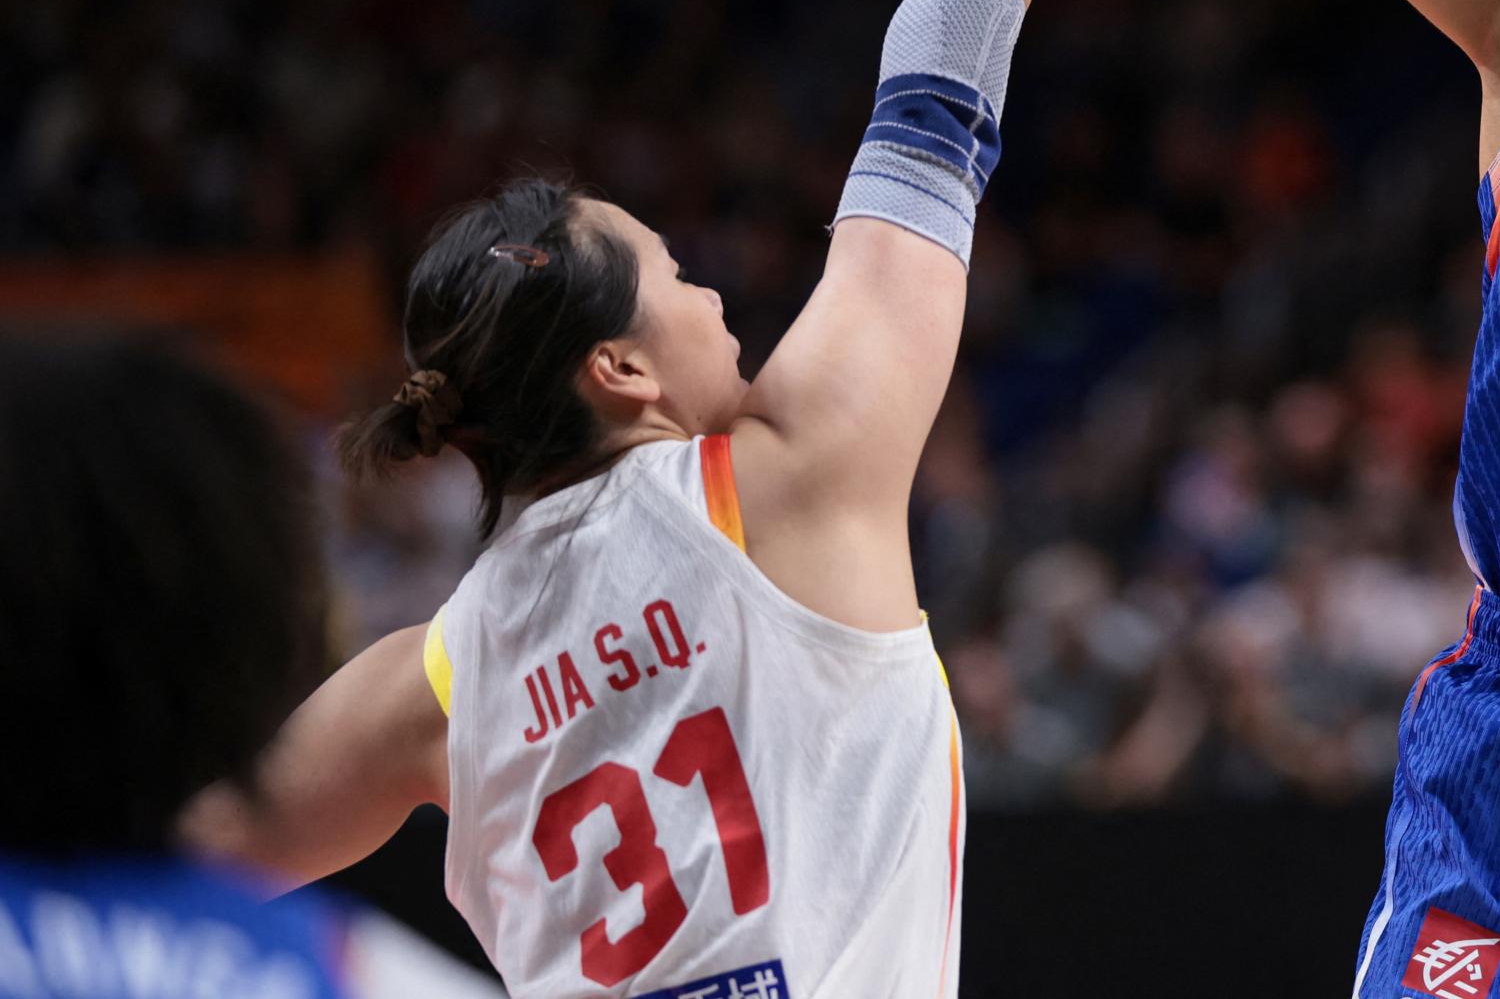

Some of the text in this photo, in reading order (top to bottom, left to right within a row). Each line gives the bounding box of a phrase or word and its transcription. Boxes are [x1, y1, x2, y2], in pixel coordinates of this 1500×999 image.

[523, 598, 707, 744] JIA S.Q.
[532, 706, 770, 987] 31
